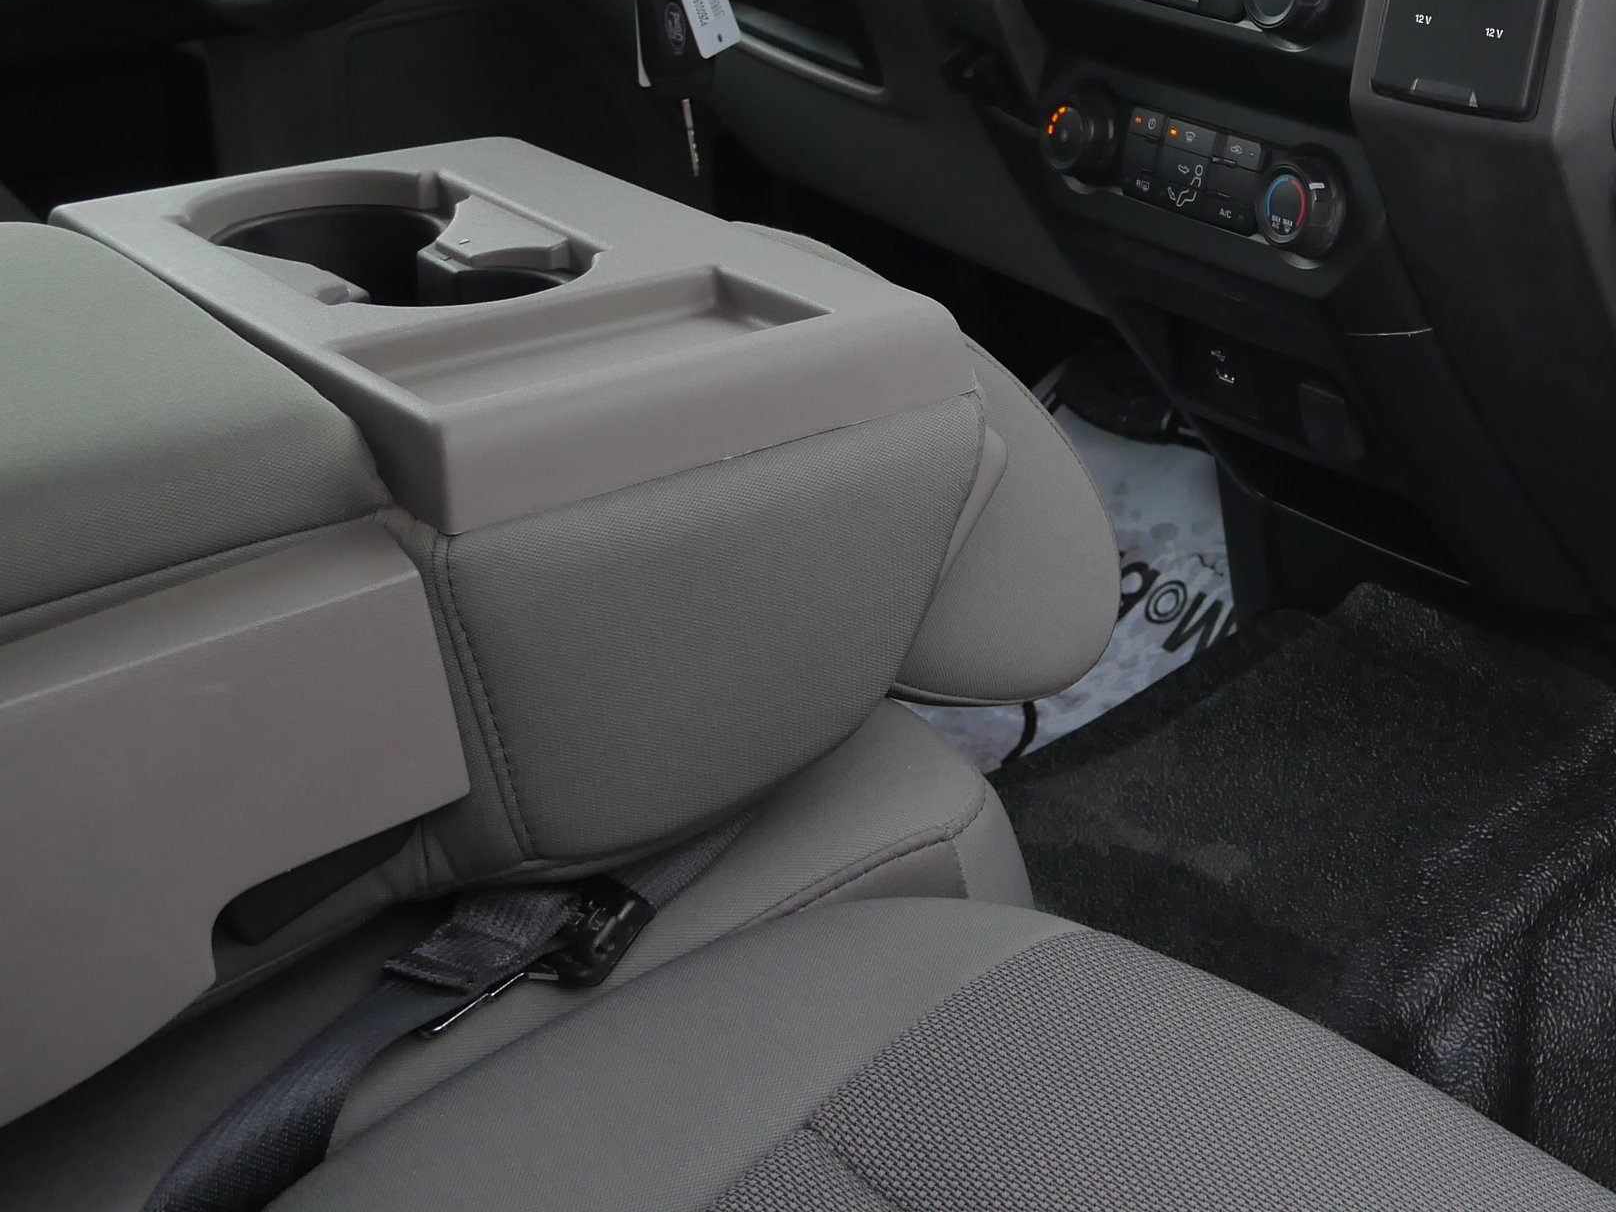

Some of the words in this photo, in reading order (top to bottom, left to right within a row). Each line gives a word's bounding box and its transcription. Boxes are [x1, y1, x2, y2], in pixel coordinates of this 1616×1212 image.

[1415, 14, 1424, 24] 12
[1425, 16, 1432, 25] V
[1486, 27, 1495, 38] 12
[1496, 29, 1504, 39] V
[1219, 208, 1232, 220] A/C
